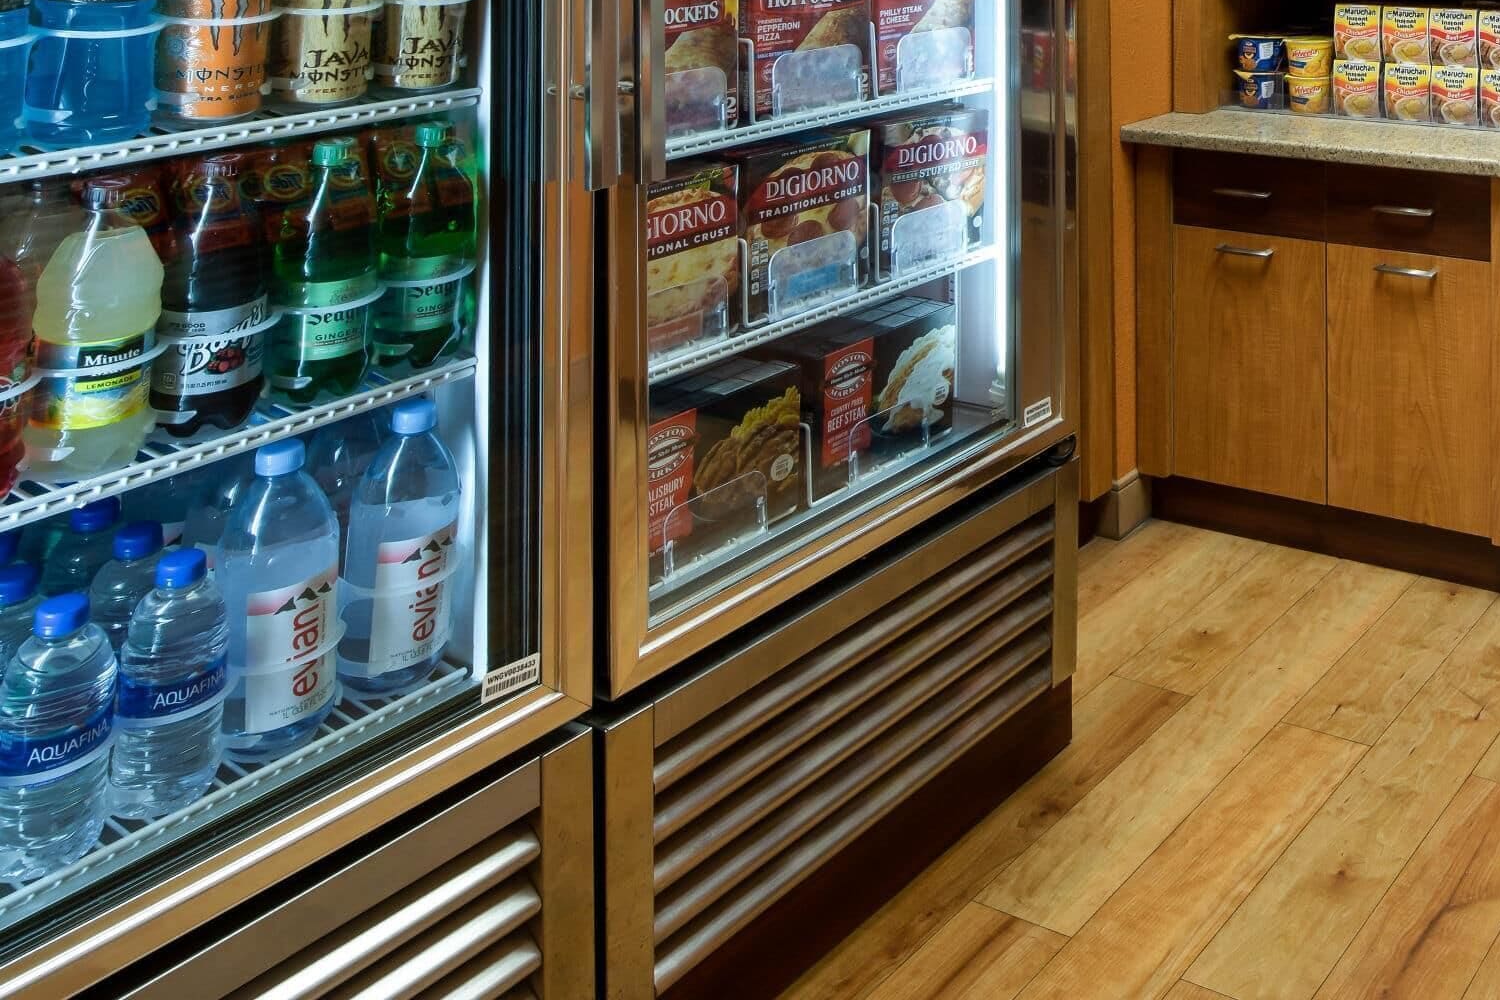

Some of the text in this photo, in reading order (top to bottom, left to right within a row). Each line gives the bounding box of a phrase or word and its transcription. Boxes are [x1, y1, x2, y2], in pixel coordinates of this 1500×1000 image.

[880, 5, 923, 18] PHILLY STEAK
[885, 14, 911, 24] CHEESE
[1345, 8, 1376, 16] Maruchan
[1393, 10, 1425, 18] Maruchan
[1440, 12, 1473, 20] Maruchan
[757, 21, 801, 34] PEPPERONI
[757, 32, 780, 42] PIZZA
[304, 42, 369, 68] JAVA
[1343, 63, 1375, 72] Maruchan
[919, 161, 962, 178] STUFFED
[758, 183, 864, 220] TRADITIONAL CRUST
[693, 225, 731, 244] CRUST
[83, 348, 141, 368] Minute
[86, 374, 134, 390] LEMONADE
[827, 405, 866, 433] BEEF STEAK
[650, 493, 675, 516] STEAK
[409, 552, 441, 642] evian
[286, 603, 319, 697] evian
[152, 667, 225, 711] AQUAFINA
[26, 718, 109, 768] AQUAFINA
